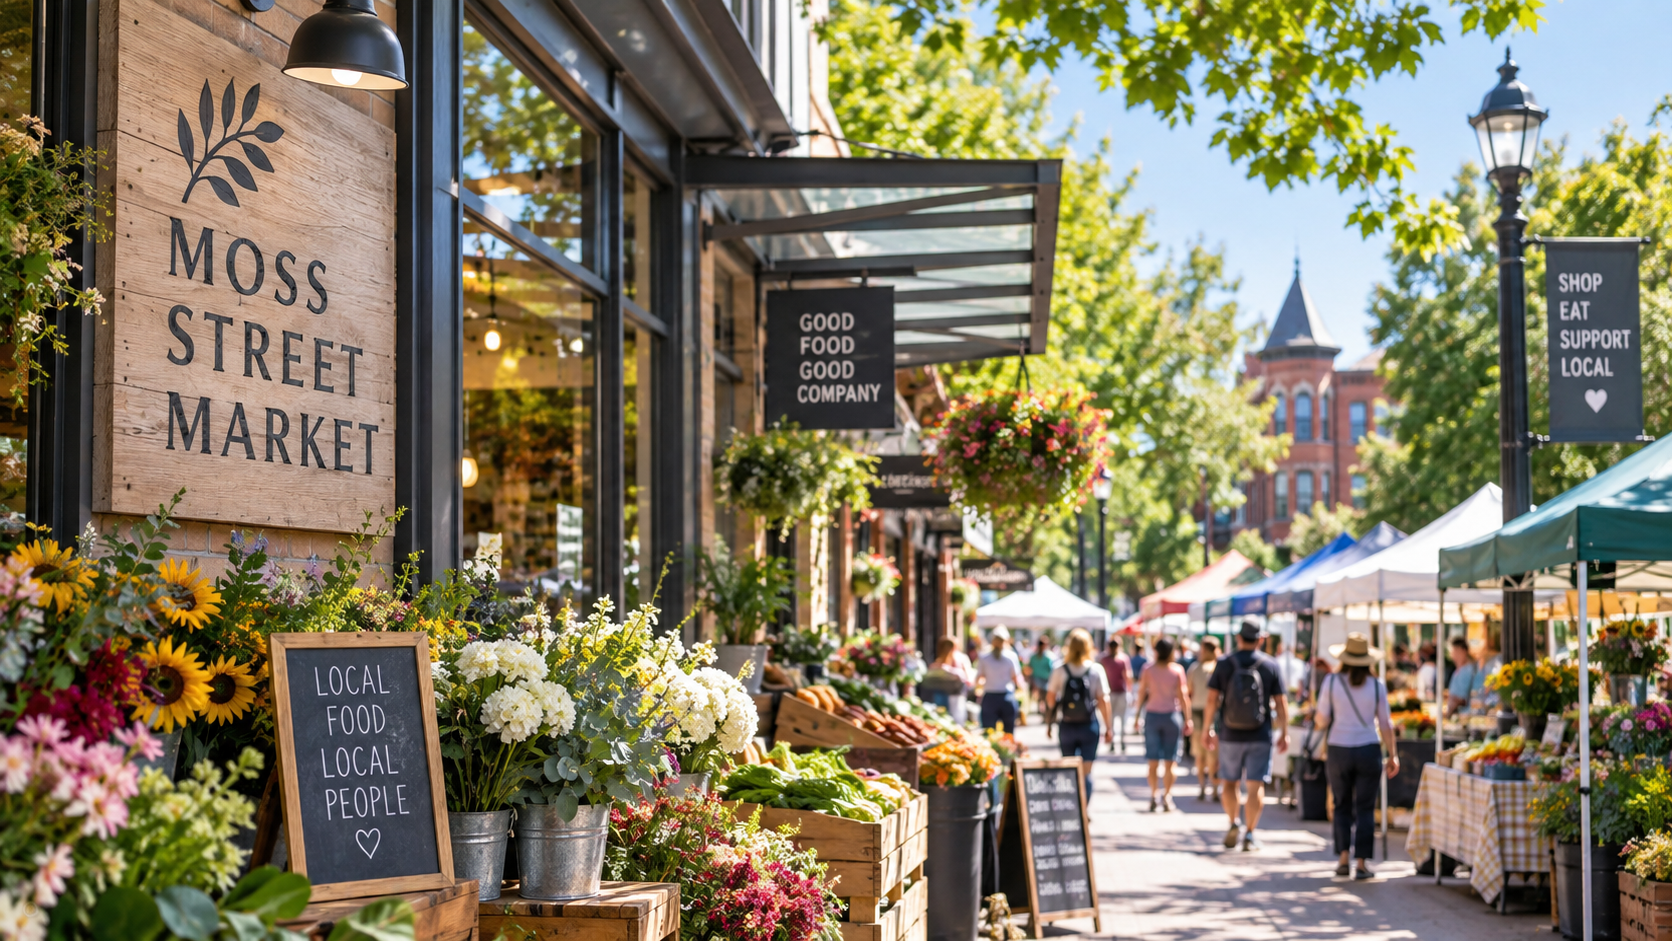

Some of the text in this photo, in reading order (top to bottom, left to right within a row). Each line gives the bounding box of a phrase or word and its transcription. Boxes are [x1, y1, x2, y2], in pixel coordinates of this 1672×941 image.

[169, 216, 328, 314] MOSS
[1558, 272, 1603, 293] SHOP
[1559, 301, 1591, 321] EAT
[799, 312, 855, 332] GOOD
[800, 336, 855, 355] FOOD
[1560, 329, 1631, 350] SUPPORT
[167, 304, 363, 397] STREET
[799, 360, 855, 380] GOOD
[1561, 357, 1614, 377] LOCAL
[797, 383, 882, 403] COMPANY
[165, 391, 379, 475] MARKET
[314, 664, 390, 696] LOCAL
[326, 704, 386, 736] FOOD
[321, 744, 399, 778] LOCAL
[325, 784, 410, 820] PEOPLE
